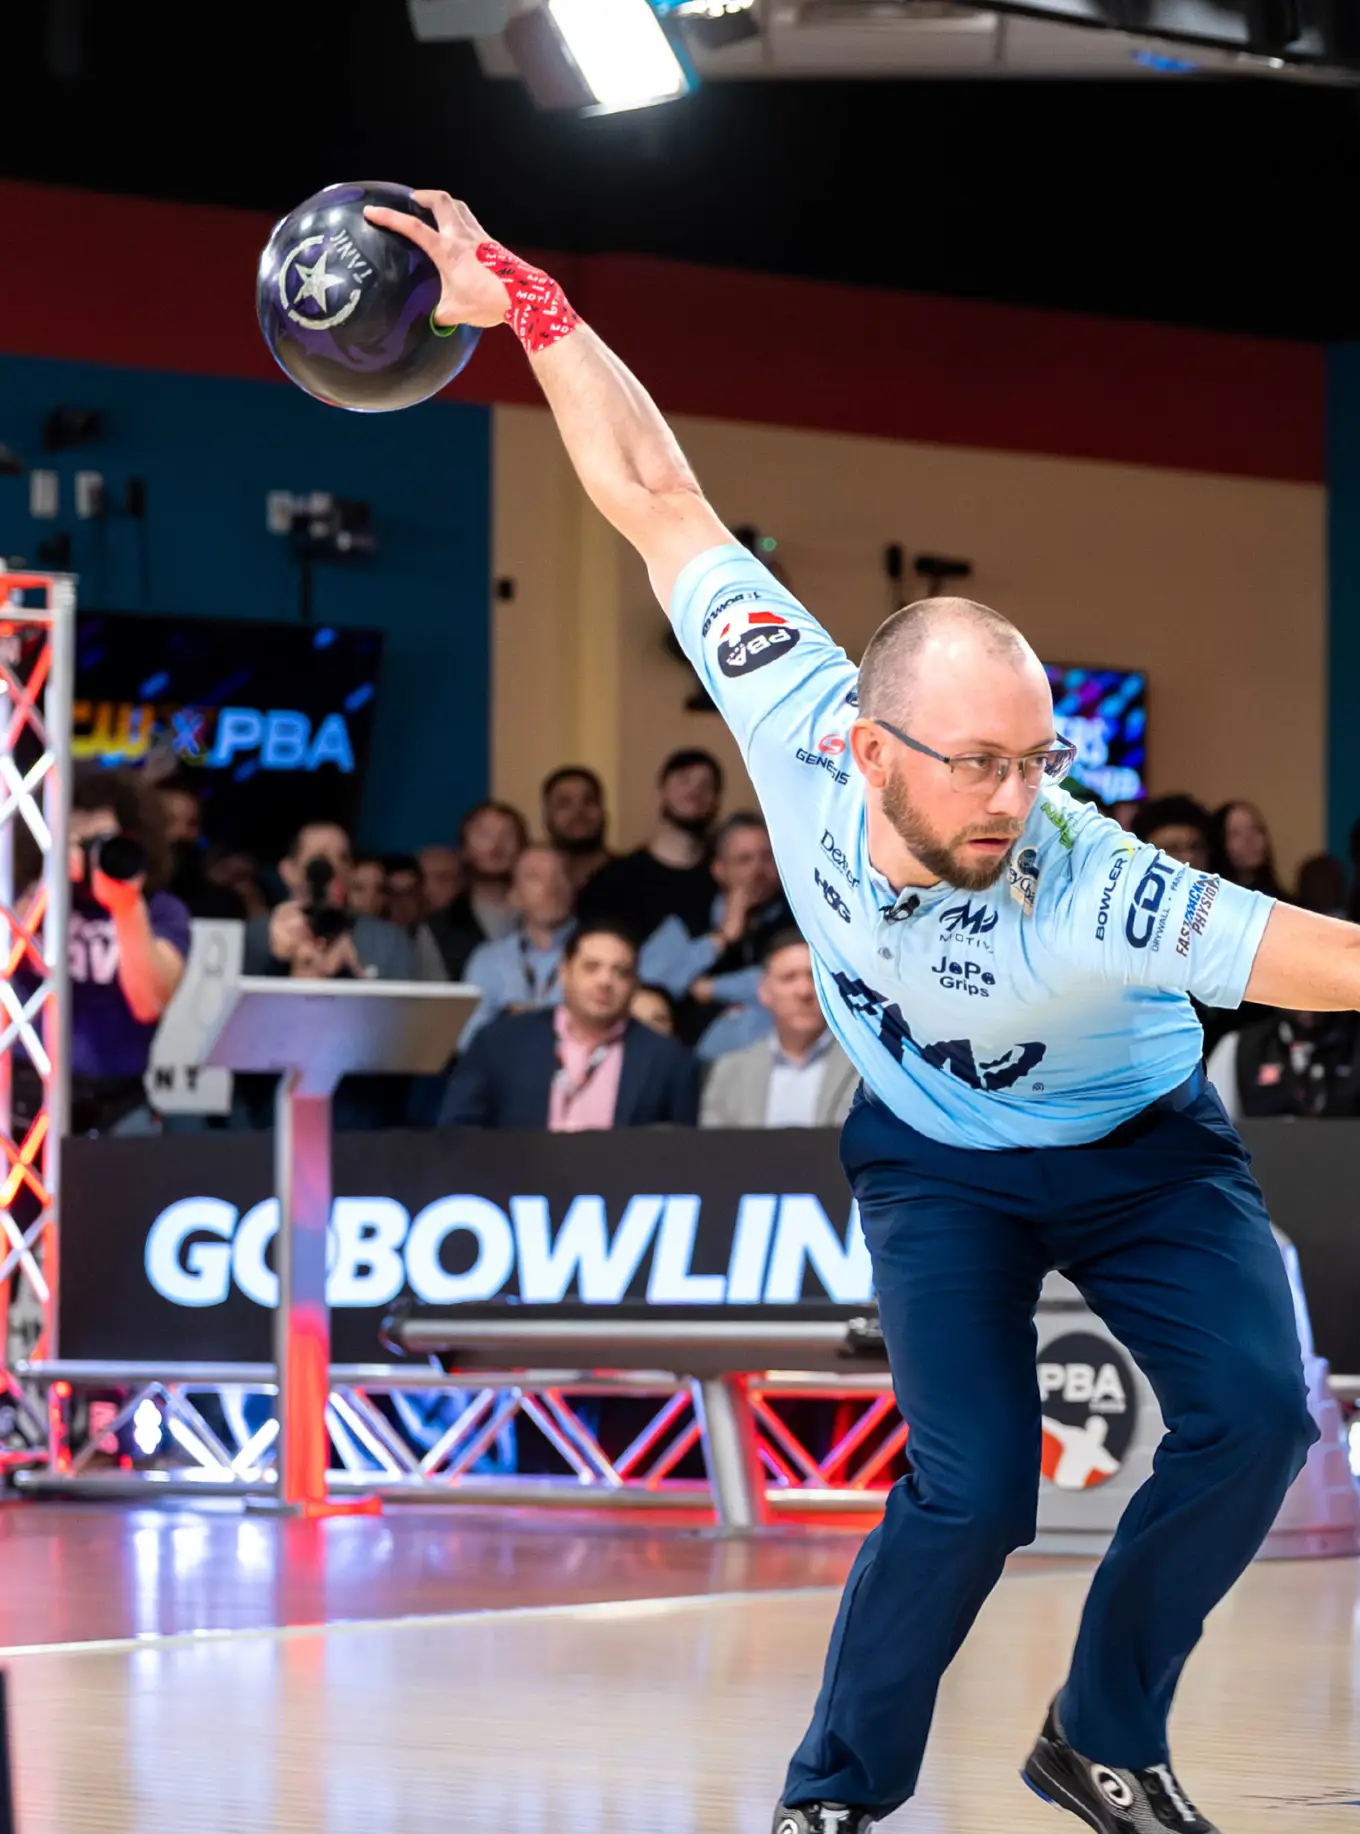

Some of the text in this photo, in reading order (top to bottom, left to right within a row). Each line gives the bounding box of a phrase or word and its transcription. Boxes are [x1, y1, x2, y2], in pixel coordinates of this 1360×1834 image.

[726, 629, 791, 667] PBA
[206, 707, 354, 773] PBA
[939, 976, 990, 998] Grips
[1037, 1363, 1126, 1403] PBA
